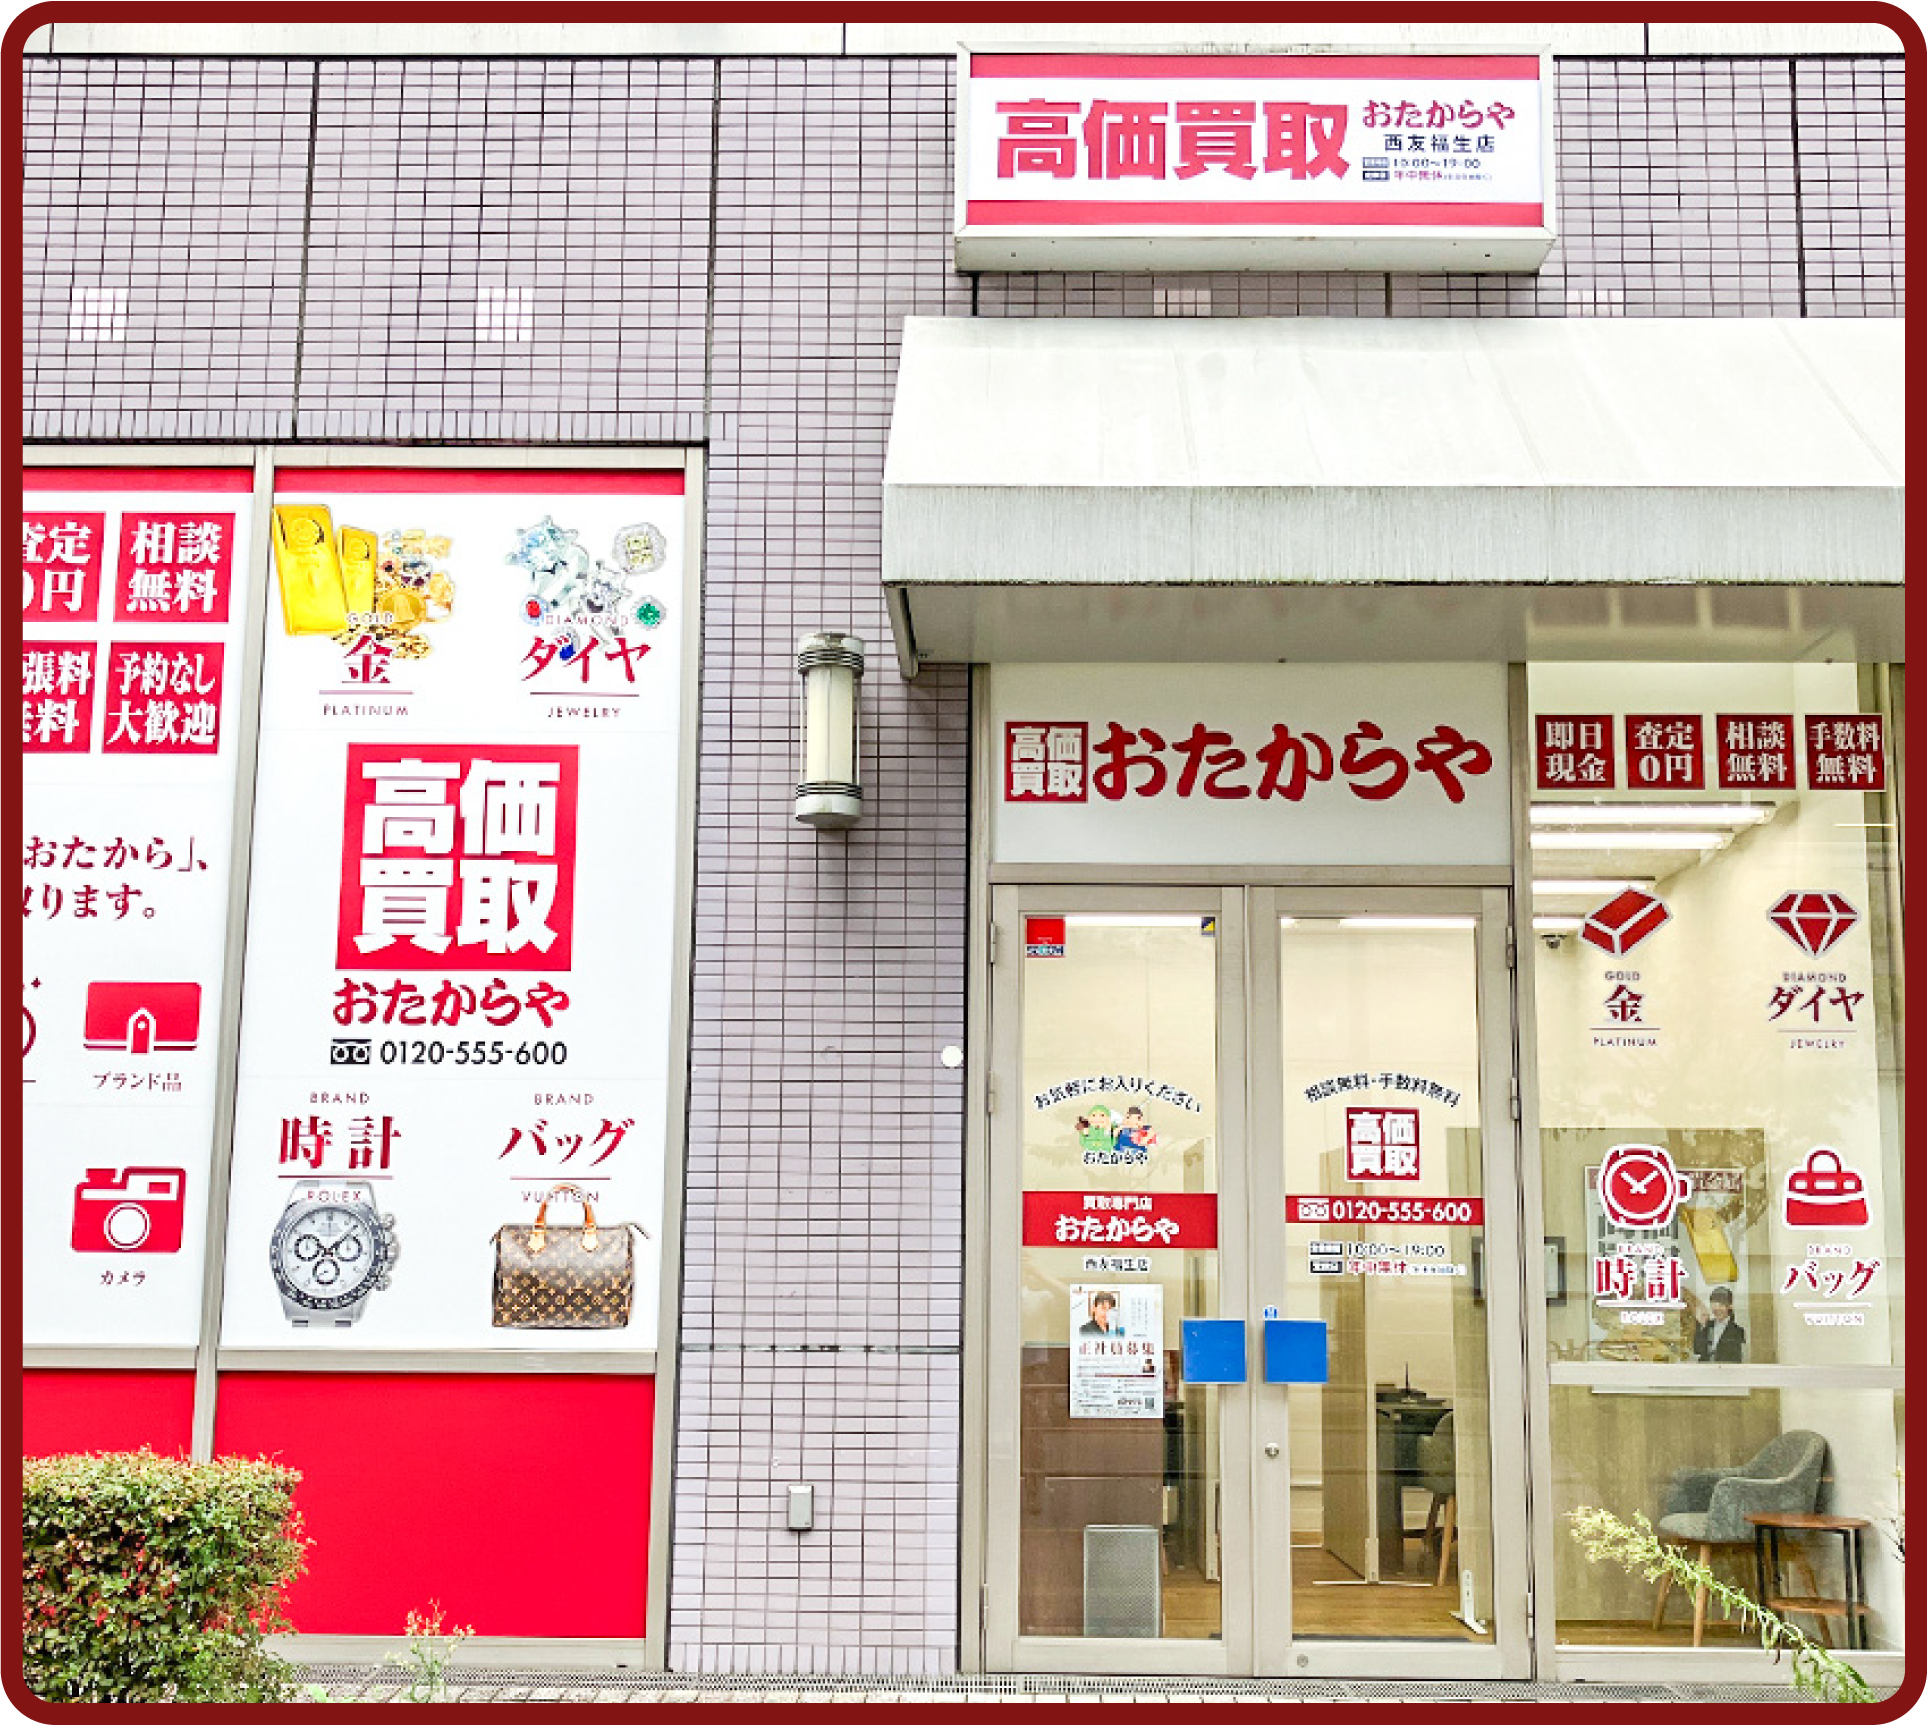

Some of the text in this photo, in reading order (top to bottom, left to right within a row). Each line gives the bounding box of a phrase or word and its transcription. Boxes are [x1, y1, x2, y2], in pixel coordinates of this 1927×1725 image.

[1363, 100, 1515, 130] おたからや
[996, 99, 1351, 180] 高価買取
[1383, 134, 1495, 153] 西友福生店
[131, 521, 223, 564] 相談
[126, 568, 218, 613] 無料
[114, 651, 216, 695] 予約なし
[341, 634, 394, 684] 金
[520, 635, 651, 684] ダイヤ
[23, 699, 80, 743] 料
[106, 699, 216, 745] 大歓迎
[323, 704, 409, 717] PLATINUM
[547, 706, 622, 719] JEWELRY
[1009, 726, 1083, 761] 高価
[1544, 721, 1604, 750] 即日
[1634, 721, 1695, 750] 査定
[1725, 721, 1786, 750] 相談
[1809, 721, 1881, 751] 手数料
[1093, 721, 1493, 803] おたからや
[1545, 752, 1606, 782] 現金
[1638, 753, 1694, 782] 0円
[1726, 753, 1788, 783] 無料
[1816, 753, 1877, 783] 無料
[1010, 762, 1083, 797] 買取
[361, 758, 560, 856] 高価
[353, 857, 558, 954] 買取
[333, 978, 570, 1028] おたからや
[1603, 984, 1645, 1022] 金
[1767, 984, 1865, 1022] ダイヤ
[380, 1040, 567, 1064] 0120-555-600
[1593, 1036, 1657, 1048] PLATINUM
[92, 1071, 182, 1092] ブランド品
[309, 1091, 370, 1105] BRAND
[534, 1093, 595, 1106] BRAND
[278, 1115, 402, 1169] 時計
[498, 1118, 636, 1167] バッグ
[1348, 1111, 1416, 1145] 高価
[1350, 1145, 1418, 1176] 買取
[1333, 1200, 1472, 1222] 0120-555-600
[1054, 1213, 1180, 1244] おたからや
[100, 1270, 146, 1287] カメラ
[1595, 1258, 1687, 1299] 時計
[1782, 1259, 1881, 1297] バッグ
